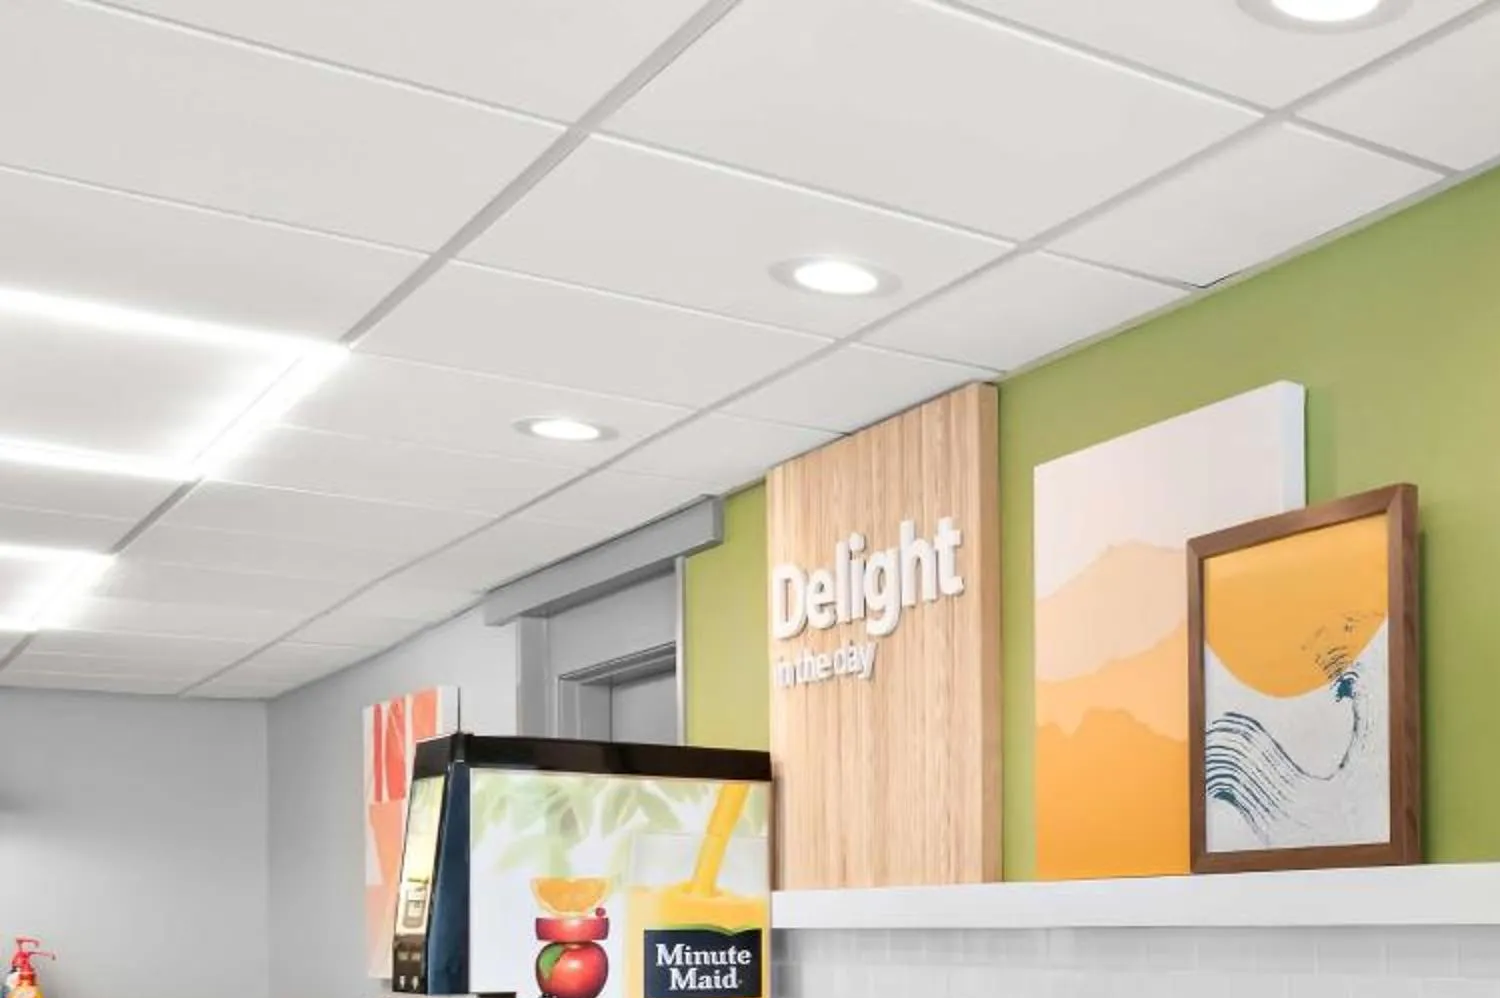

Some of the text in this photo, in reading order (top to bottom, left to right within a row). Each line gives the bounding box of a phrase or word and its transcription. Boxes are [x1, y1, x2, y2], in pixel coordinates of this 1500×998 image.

[772, 515, 964, 641] Delight
[776, 642, 877, 688] in the day
[655, 943, 752, 966] Minute
[669, 966, 738, 990] Maid
